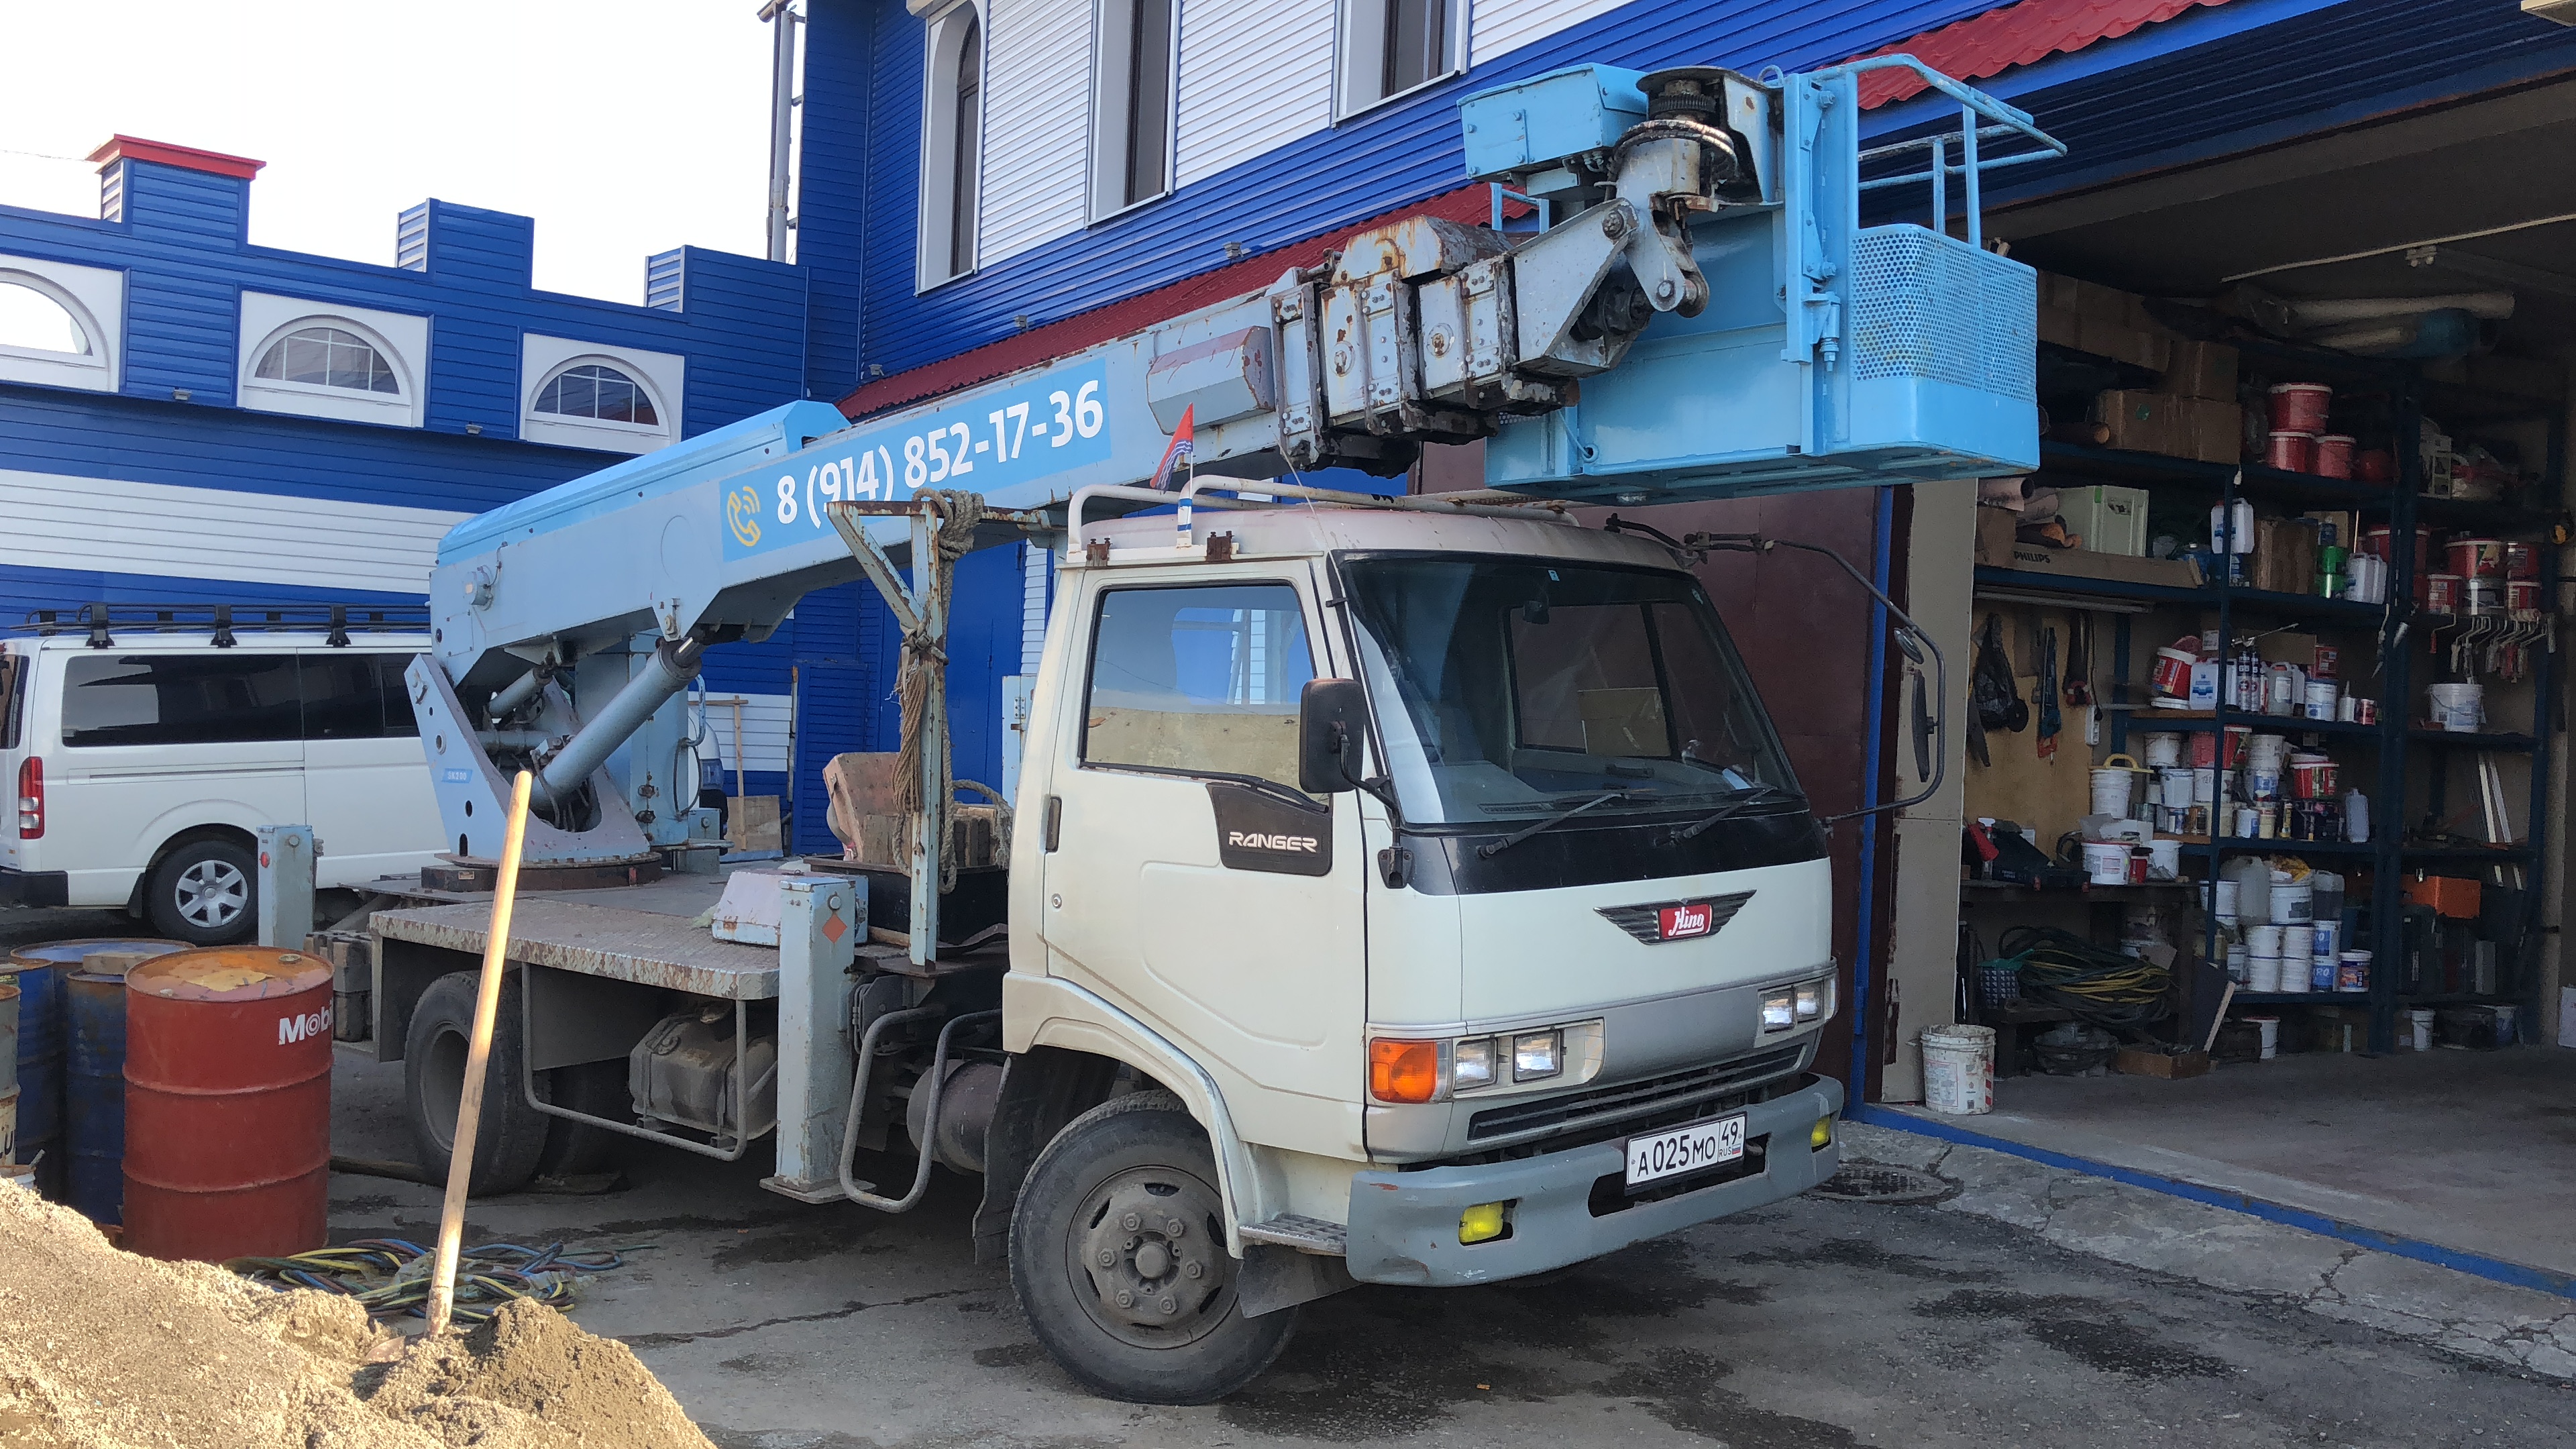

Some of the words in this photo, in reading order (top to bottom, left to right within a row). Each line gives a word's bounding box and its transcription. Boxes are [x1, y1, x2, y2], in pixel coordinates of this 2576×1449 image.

[777, 475, 798, 525] 8
[806, 444, 894, 529] (914)
[904, 380, 1104, 488] 852-17-36
[2013, 551, 2051, 564] PHILIPS
[1228, 831, 1318, 853] RANGER
[1668, 906, 1705, 936] Hino
[1721, 1121, 1739, 1146] 49
[1719, 1146, 1732, 1158] RUS
